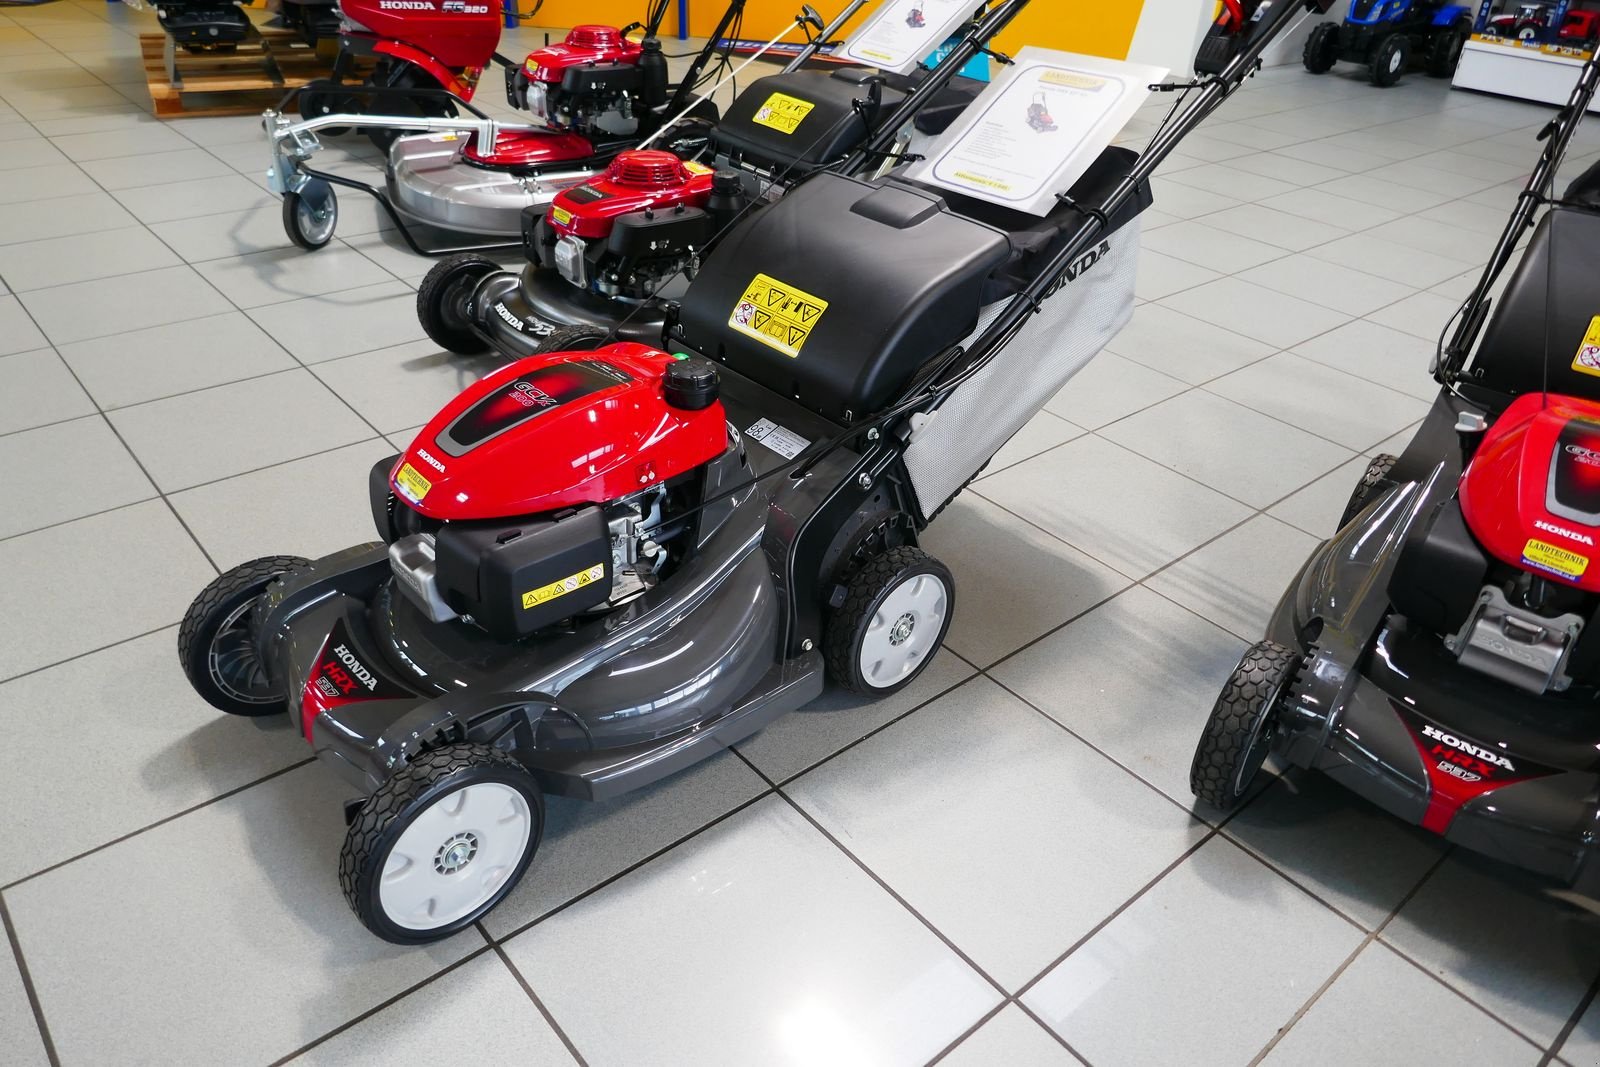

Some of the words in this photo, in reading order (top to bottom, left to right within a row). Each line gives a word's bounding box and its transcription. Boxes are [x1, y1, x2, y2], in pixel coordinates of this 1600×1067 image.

[380, 0, 436, 10] HONDA
[494, 302, 524, 331] HONDA
[747, 424, 764, 437] 98
[417, 448, 446, 474] HONDA
[1533, 520, 1594, 547] HONDA
[1528, 540, 1585, 566] LANDTECHNIK
[323, 661, 358, 695] HRX
[334, 643, 378, 691] HONDA
[314, 676, 340, 697] 537
[1421, 724, 1515, 772] HONDA
[1431, 744, 1496, 778] HRX
[1436, 760, 1482, 782] 537
